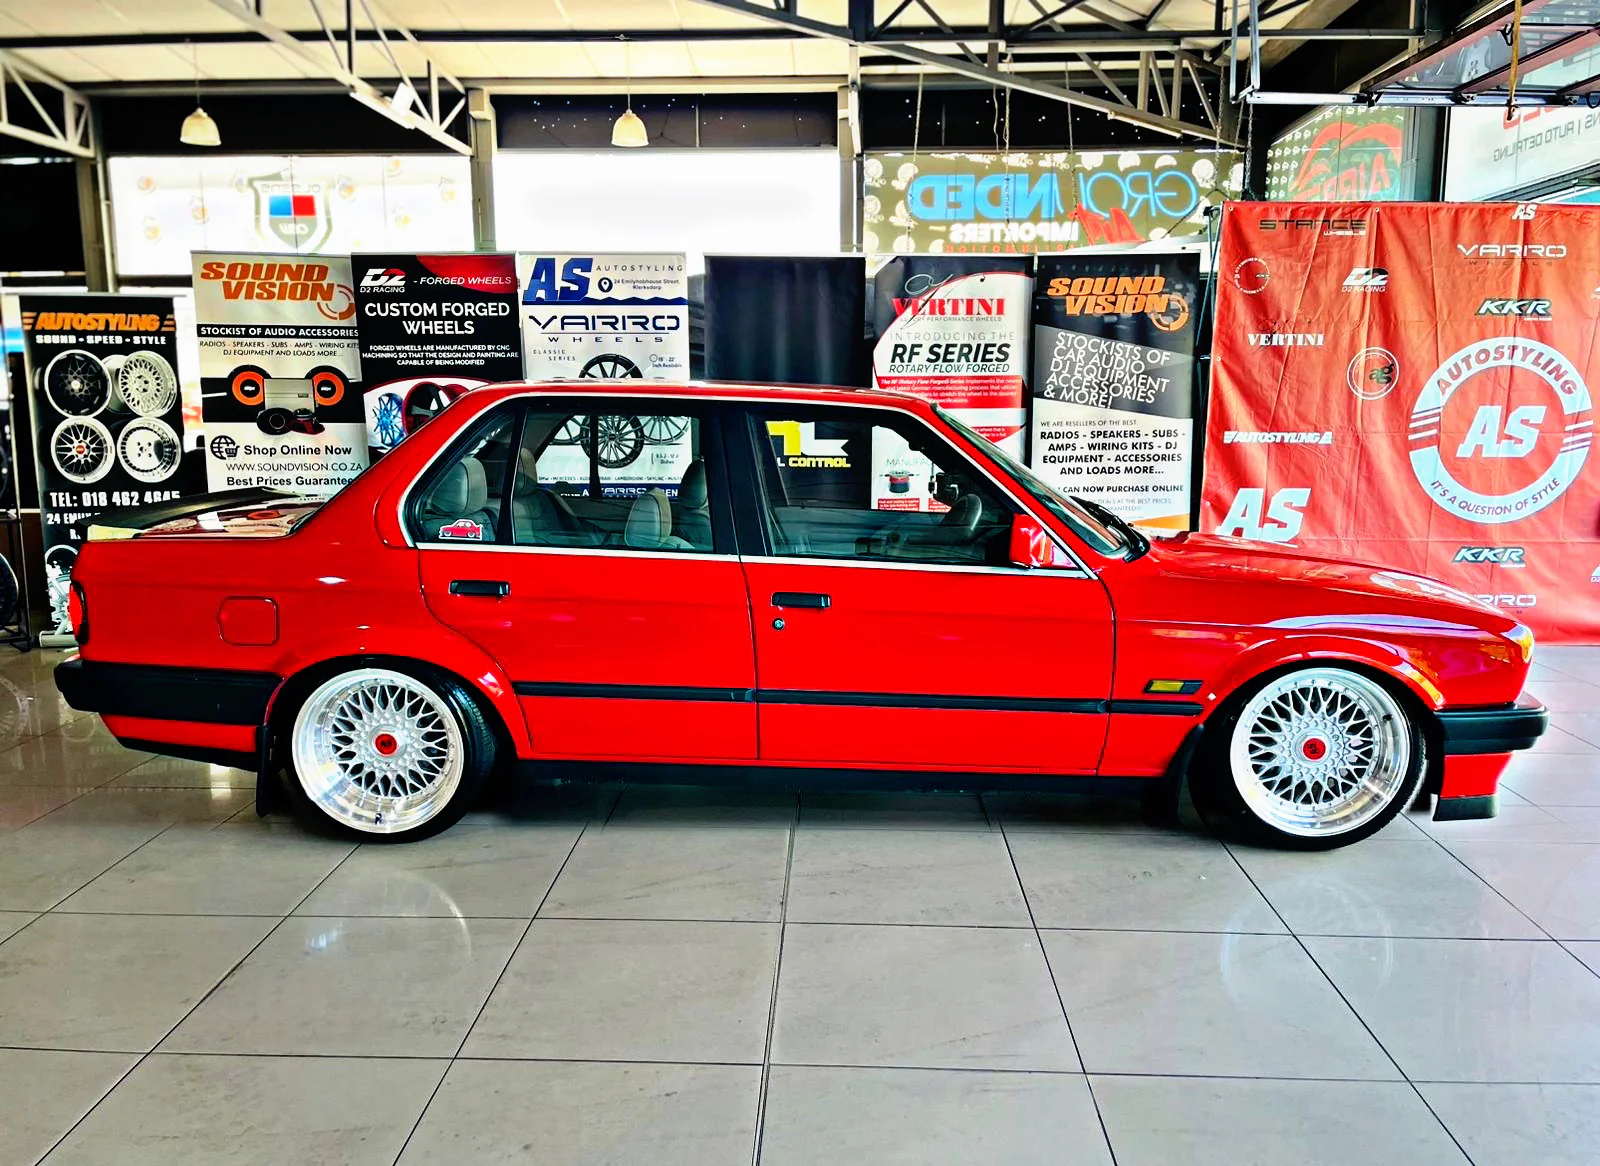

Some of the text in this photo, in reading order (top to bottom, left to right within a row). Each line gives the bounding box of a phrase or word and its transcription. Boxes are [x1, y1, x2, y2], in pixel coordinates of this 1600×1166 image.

[1511, 204, 1539, 221] AS
[1259, 219, 1366, 231] STANCE
[1457, 244, 1567, 258] VARRO
[200, 262, 329, 281] SOUND
[596, 264, 684, 272] AUTOSTYLING
[420, 276, 512, 285] FORGED WHEELS
[523, 258, 594, 301] AS
[1047, 276, 1166, 297] SOUND
[222, 281, 334, 302] VISION
[365, 302, 510, 317] CUSTOM FORGED
[892, 298, 1005, 316] VERTINI
[1065, 295, 1170, 316] VISION
[1475, 298, 1552, 316] KKR
[34, 312, 161, 331] AUTOSTYLING
[402, 320, 475, 335] WHEELS
[529, 315, 681, 331] VARRO
[36, 335, 167, 344] SOUND SPEED STYLE
[200, 327, 359, 337] STOCKIST OF AUDIO ACCESSORIES
[890, 332, 986, 341] INTRODUCING
[1248, 333, 1325, 346] VERTINI
[891, 343, 1011, 364] RF SERIES
[1056, 331, 1171, 366] STOCKISTS OF
[889, 364, 1010, 373] ROTARY FLOW FORGED
[1053, 346, 1145, 376] CAR AUDIO
[1050, 358, 1170, 393] DJ EQUIPMENT
[1436, 344, 1578, 396] AUTOSTYLING
[1046, 372, 1156, 405] ACCESSORIES
[1043, 385, 1113, 409] & MORE!
[1040, 429, 1178, 440] RADIOS SPEAKERS SUBS
[1456, 405, 1548, 459] AS
[244, 445, 352, 457] Shop Online Now
[1048, 441, 1178, 451] AMPS WIRING KITS DJ
[788, 457, 851, 468] CONTROL
[1043, 454, 1182, 464] EQUIPMENT ACCESSORIES
[226, 463, 363, 471] WWW.SOUNDVISION.CO.ZA
[1060, 467, 1082, 475] AND
[1086, 466, 1120, 475] LOADS
[227, 476, 253, 486] Best
[257, 476, 292, 486] Prices
[1106, 485, 1149, 493] PURCHASE
[1430, 477, 1560, 515] IT'S A QUESTION OF STYLE
[50, 492, 78, 507] TEL:
[47, 513, 61, 525] 24
[1215, 487, 1311, 542] AS
[1452, 546, 1526, 563] KKR
